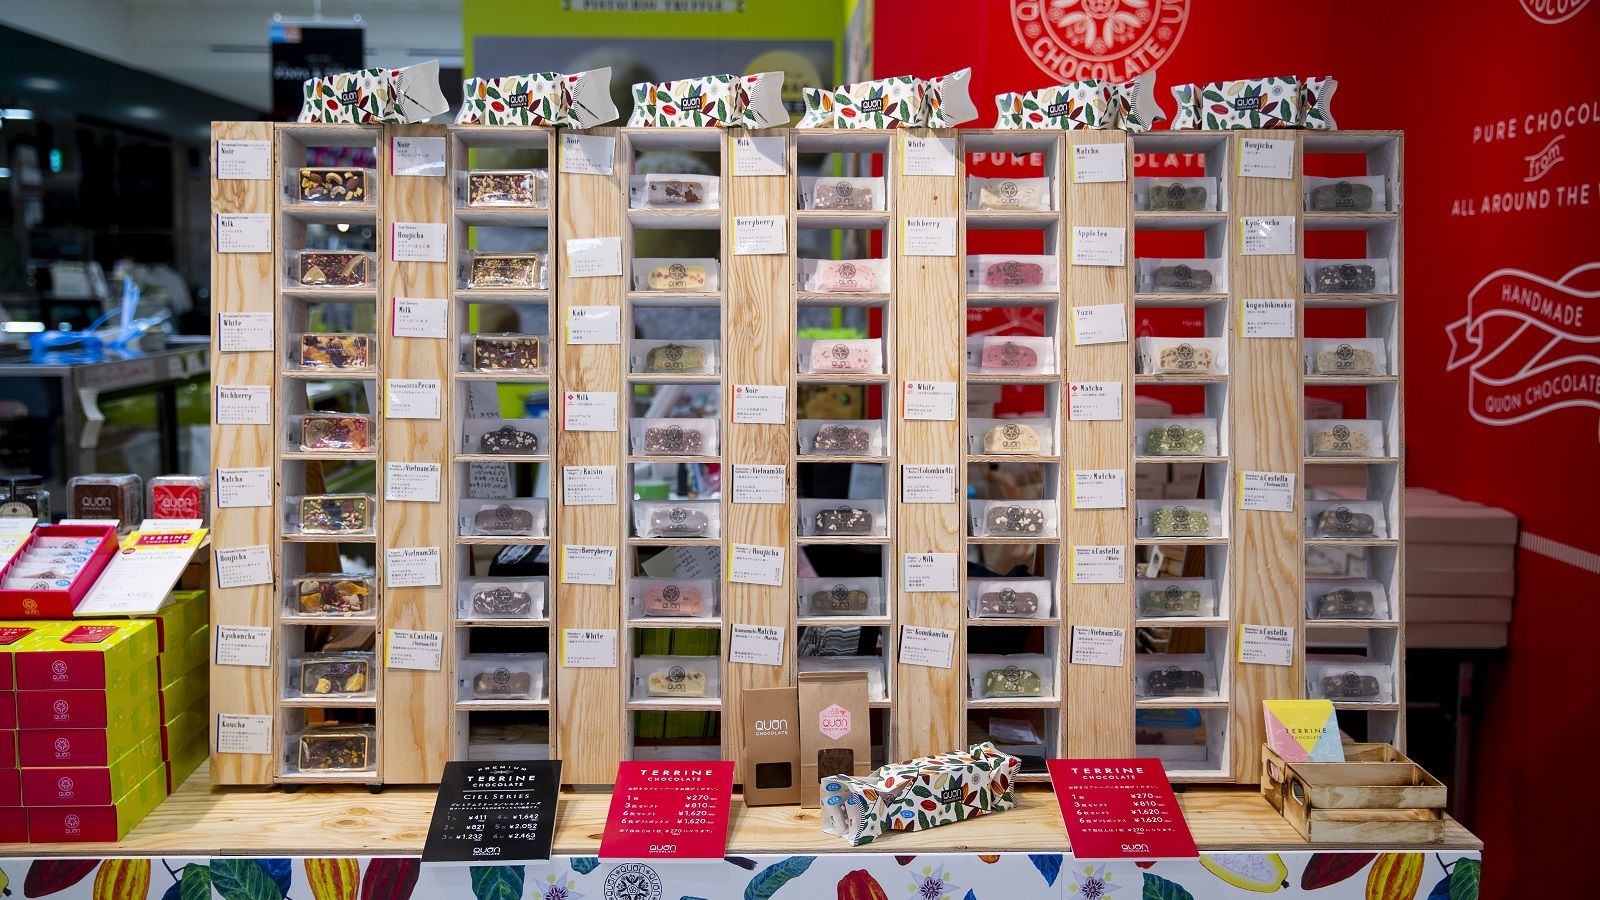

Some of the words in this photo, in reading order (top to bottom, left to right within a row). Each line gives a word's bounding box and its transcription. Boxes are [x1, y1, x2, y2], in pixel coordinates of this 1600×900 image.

[1032, 36, 1166, 84] CHOCOLATE
[1473, 118, 1517, 143] PURE
[1524, 102, 1600, 135] CHOCOL
[1245, 141, 1273, 150] Houjicha
[1451, 198, 1475, 216] ALL
[1481, 189, 1550, 213] AROUND
[1556, 184, 1590, 206] THE
[737, 219, 775, 227] Berryberry
[397, 232, 423, 240] Houjicha
[1078, 229, 1095, 238] Apple
[1502, 284, 1584, 327] HANDMADE
[221, 392, 252, 400] Richberry
[1485, 393, 1521, 413] QUON
[1525, 374, 1600, 405] CHOCOLATE
[581, 547, 613, 556] Berryberry
[753, 548, 779, 557] Houjicha
[220, 554, 247, 563] Houjicha
[757, 628, 777, 636] Matcha
